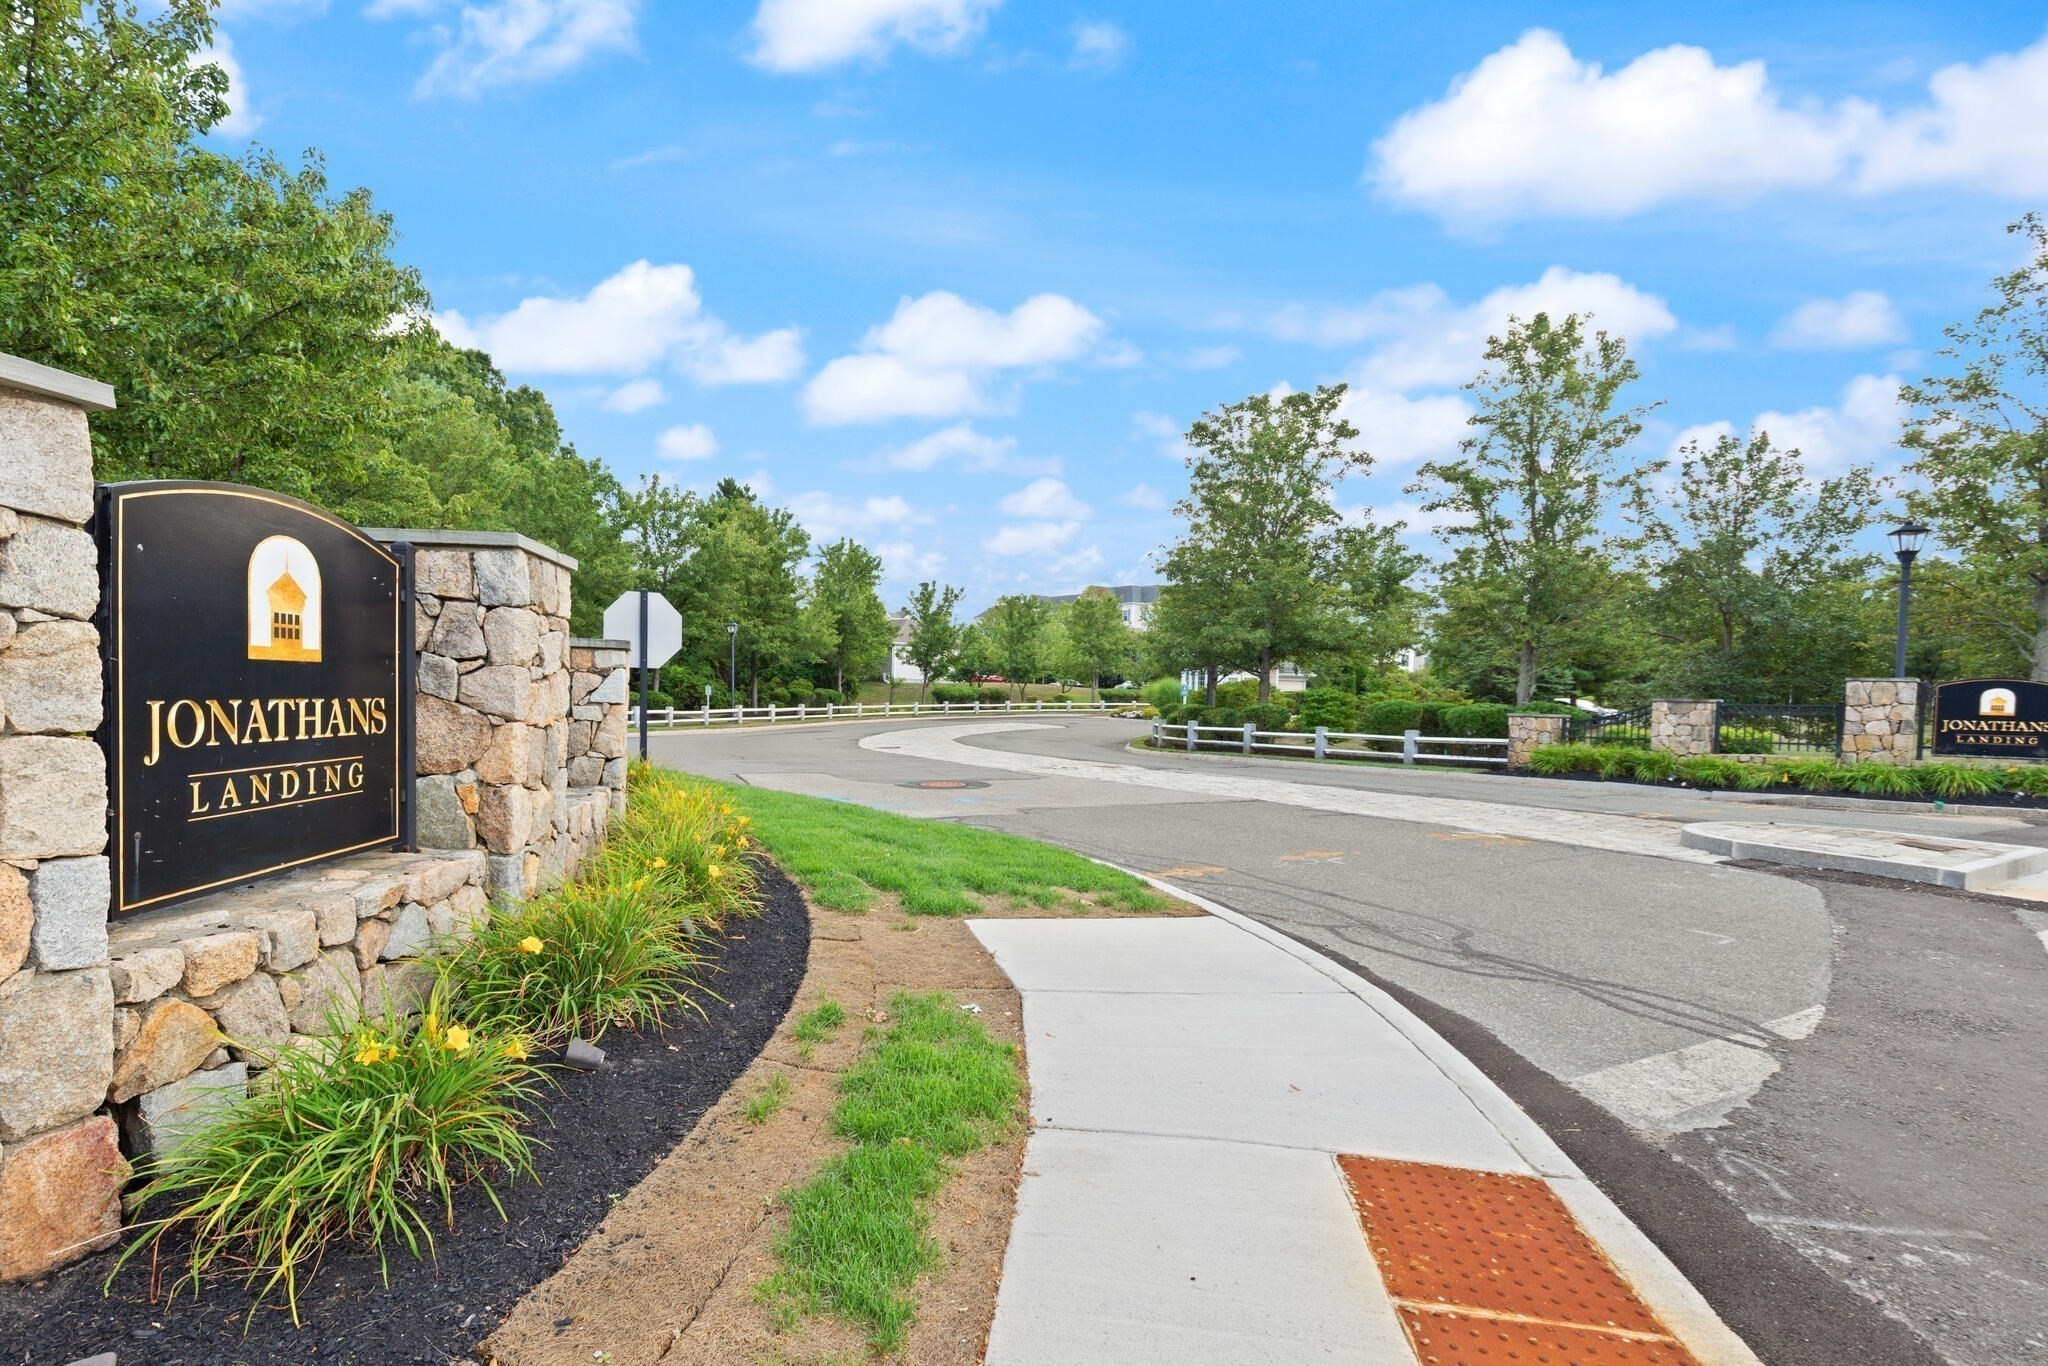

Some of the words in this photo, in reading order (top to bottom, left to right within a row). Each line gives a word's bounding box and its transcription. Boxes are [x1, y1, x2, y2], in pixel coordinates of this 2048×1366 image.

[143, 697, 387, 766] JONATHANS
[1956, 735, 2039, 745] LANDING
[189, 762, 364, 813] LANDING
